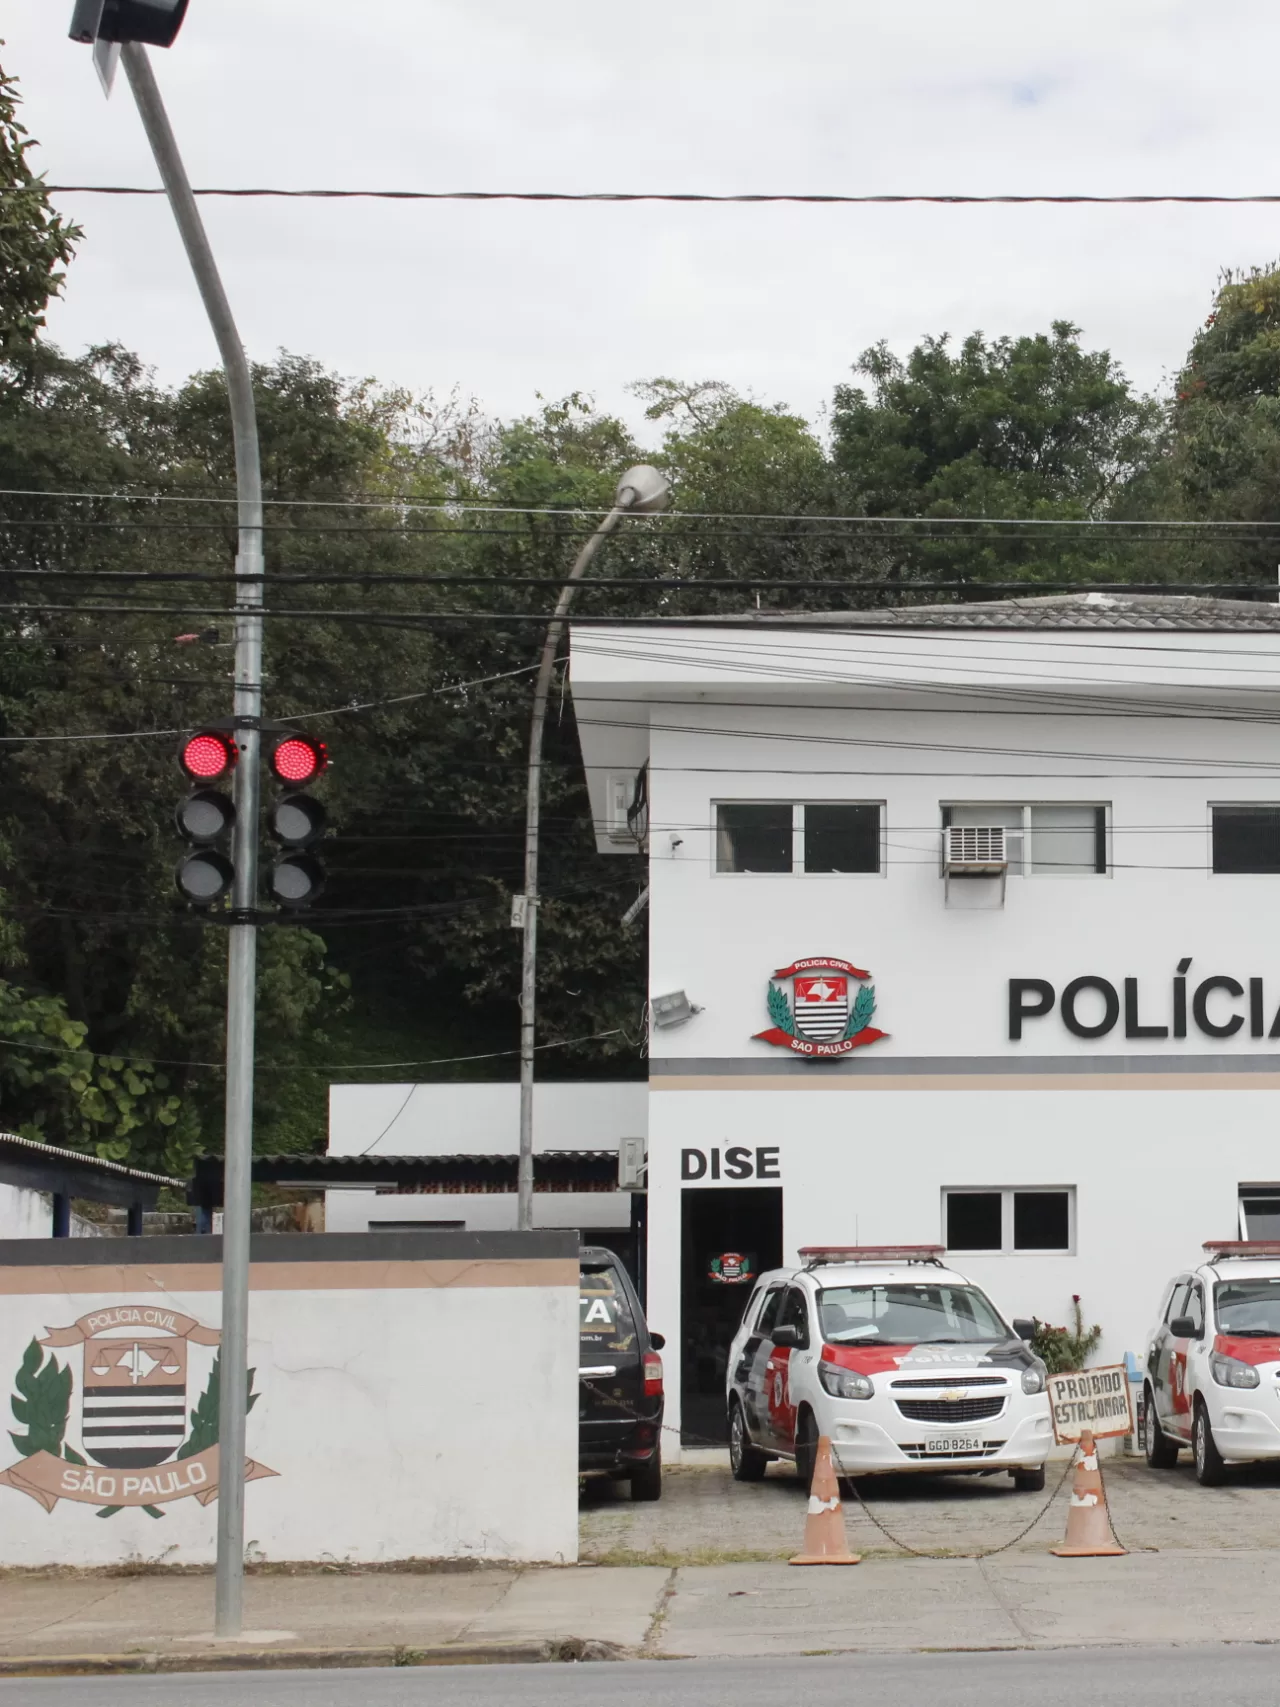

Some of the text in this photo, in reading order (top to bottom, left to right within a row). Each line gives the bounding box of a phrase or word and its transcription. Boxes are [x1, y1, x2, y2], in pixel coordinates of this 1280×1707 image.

[829, 960, 851, 971] CIVIL
[817, 1041, 852, 1054] PAULO
[681, 1146, 781, 1180] DISE
[87, 1308, 178, 1331] POLÍCIA CIVIL
[1055, 1372, 1121, 1400] PROIBIDO
[1054, 1395, 1127, 1424] ESTACIONAR
[60, 1461, 207, 1497] SÃO PAULO
